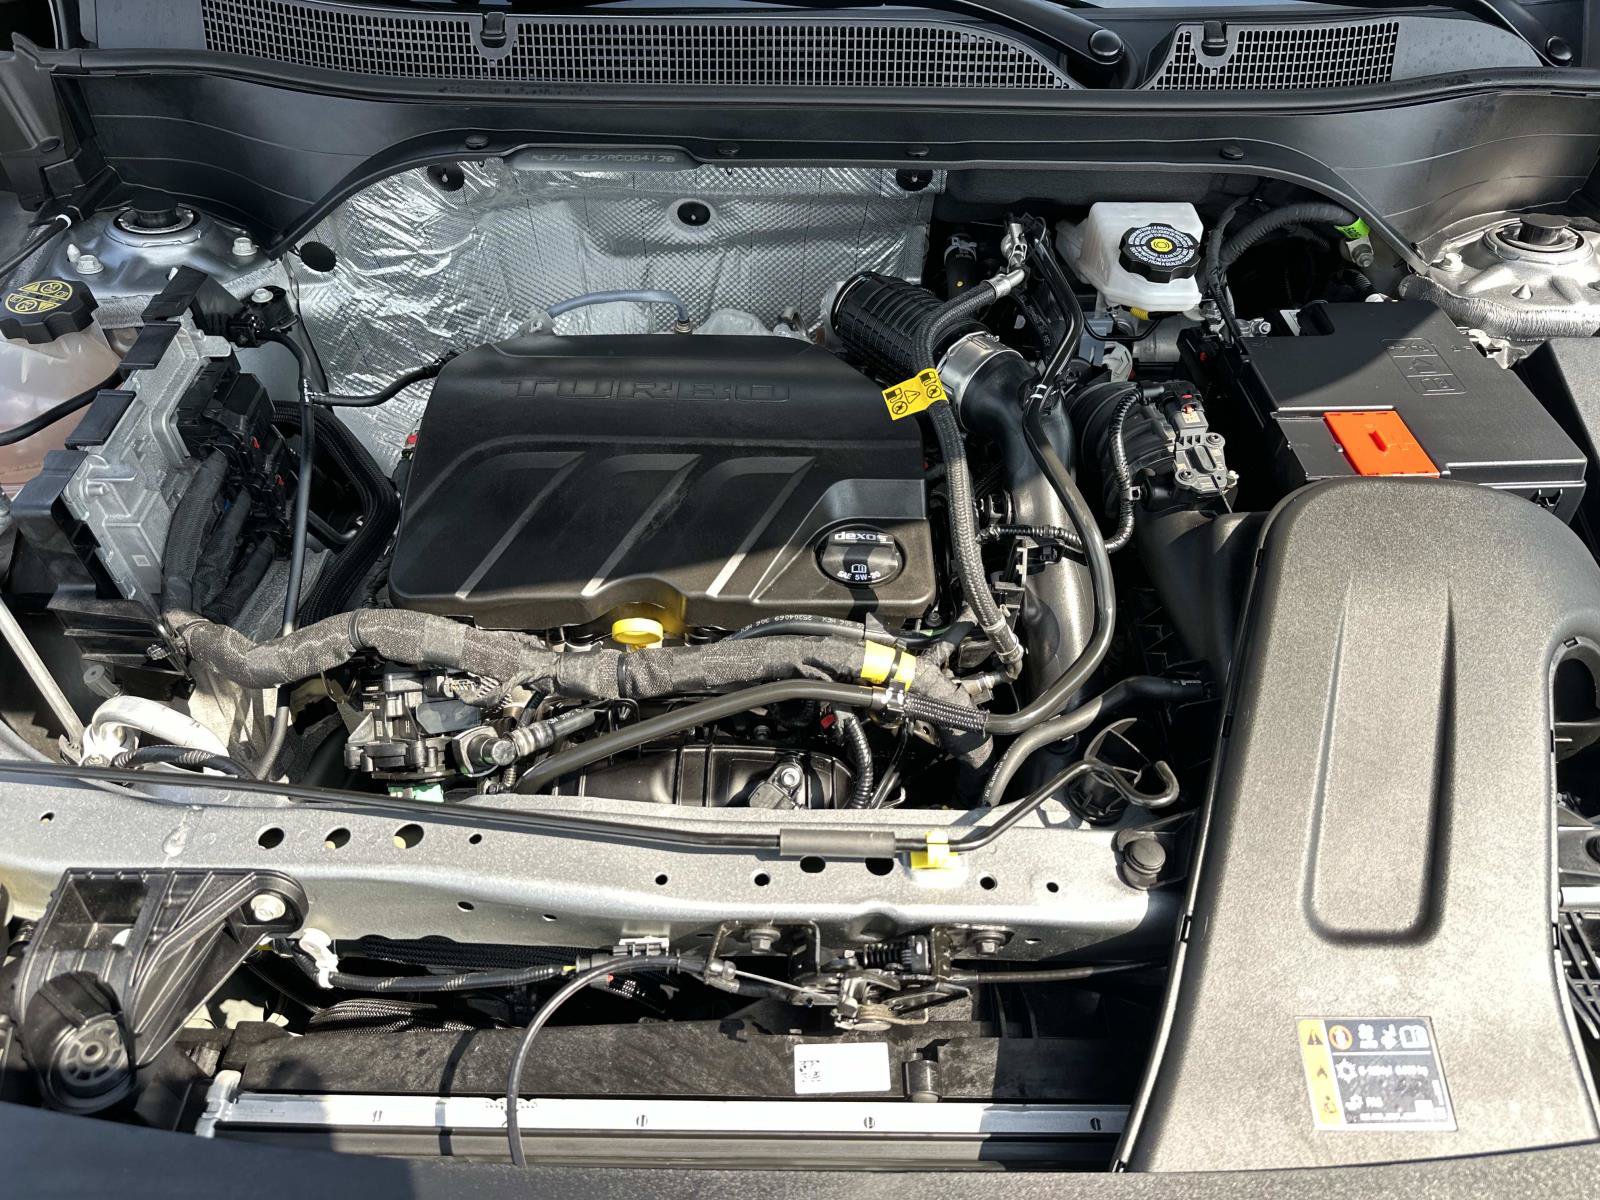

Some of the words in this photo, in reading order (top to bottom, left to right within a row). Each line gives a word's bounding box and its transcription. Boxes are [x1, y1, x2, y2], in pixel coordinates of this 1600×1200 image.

[501, 377, 789, 402] TURBO
[834, 531, 888, 542] dexos
[836, 570, 853, 580] SAE
